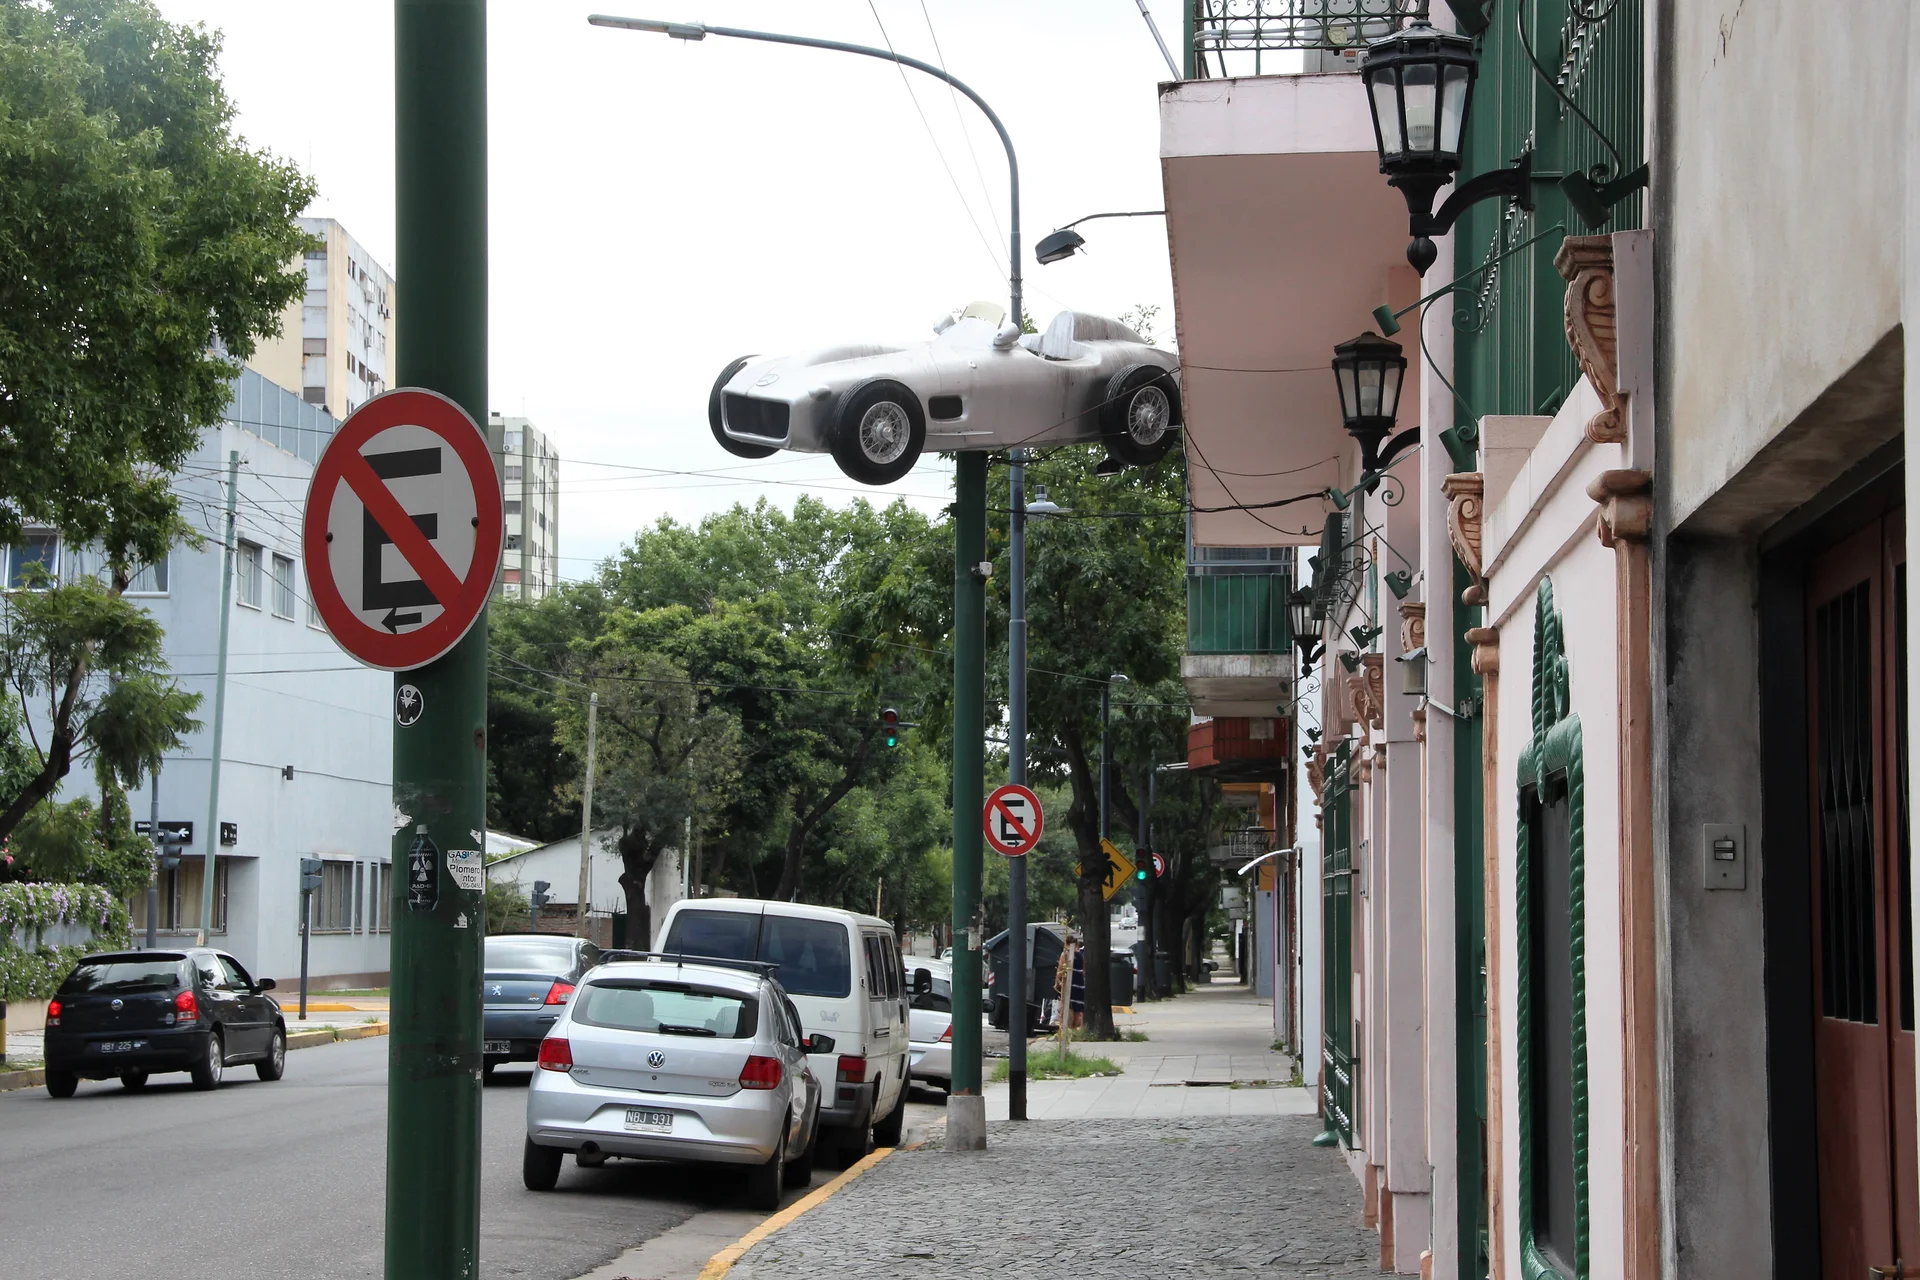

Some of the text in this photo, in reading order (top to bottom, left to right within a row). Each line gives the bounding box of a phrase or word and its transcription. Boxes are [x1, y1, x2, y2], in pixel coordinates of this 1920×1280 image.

[363, 447, 442, 611] E
[1001, 800, 1025, 840] E
[119, 1041, 132, 1050] 225
[497, 1043, 509, 1051] 192
[626, 1111, 671, 1126] NBJ 931
